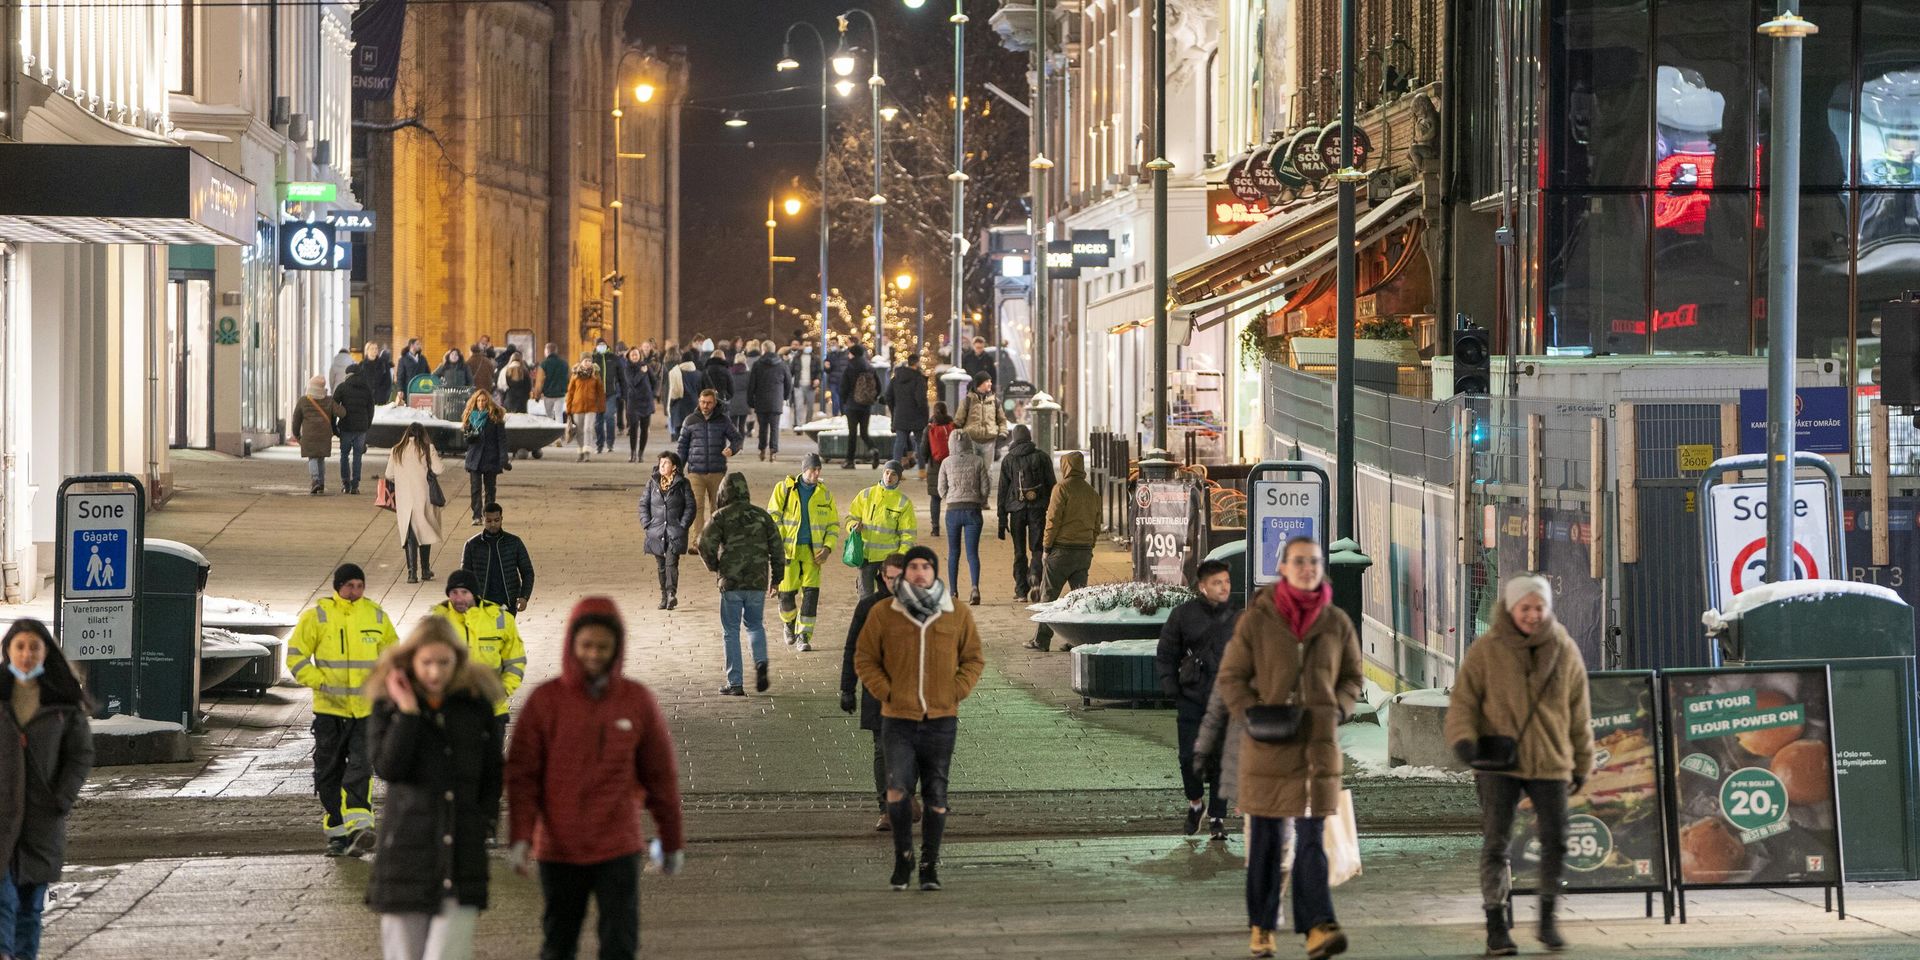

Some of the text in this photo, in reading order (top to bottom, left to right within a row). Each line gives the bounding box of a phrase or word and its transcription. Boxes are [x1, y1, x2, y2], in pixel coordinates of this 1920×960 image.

[352, 75, 391, 89] ENSIKT
[326, 215, 372, 228] ZARA
[1072, 243, 1108, 255] KICKS
[1813, 418, 1841, 427] OMRÅDE
[1682, 457, 1708, 466] 2606
[1266, 488, 1310, 506] Sone
[79, 501, 124, 519] Sone
[1733, 496, 1808, 521] Soe
[1135, 517, 1189, 526] STUDENTTILBUD
[1271, 519, 1305, 531] Gågate
[82, 532, 119, 544] Gågate
[1146, 533, 1190, 561] 299,-
[73, 605, 124, 614] Varetransport
[88, 616, 109, 625] tillatt
[1689, 695, 1751, 713] GET YOUR
[1612, 714, 1632, 725] ME
[1690, 710, 1799, 735] FLOUR POWER ON
